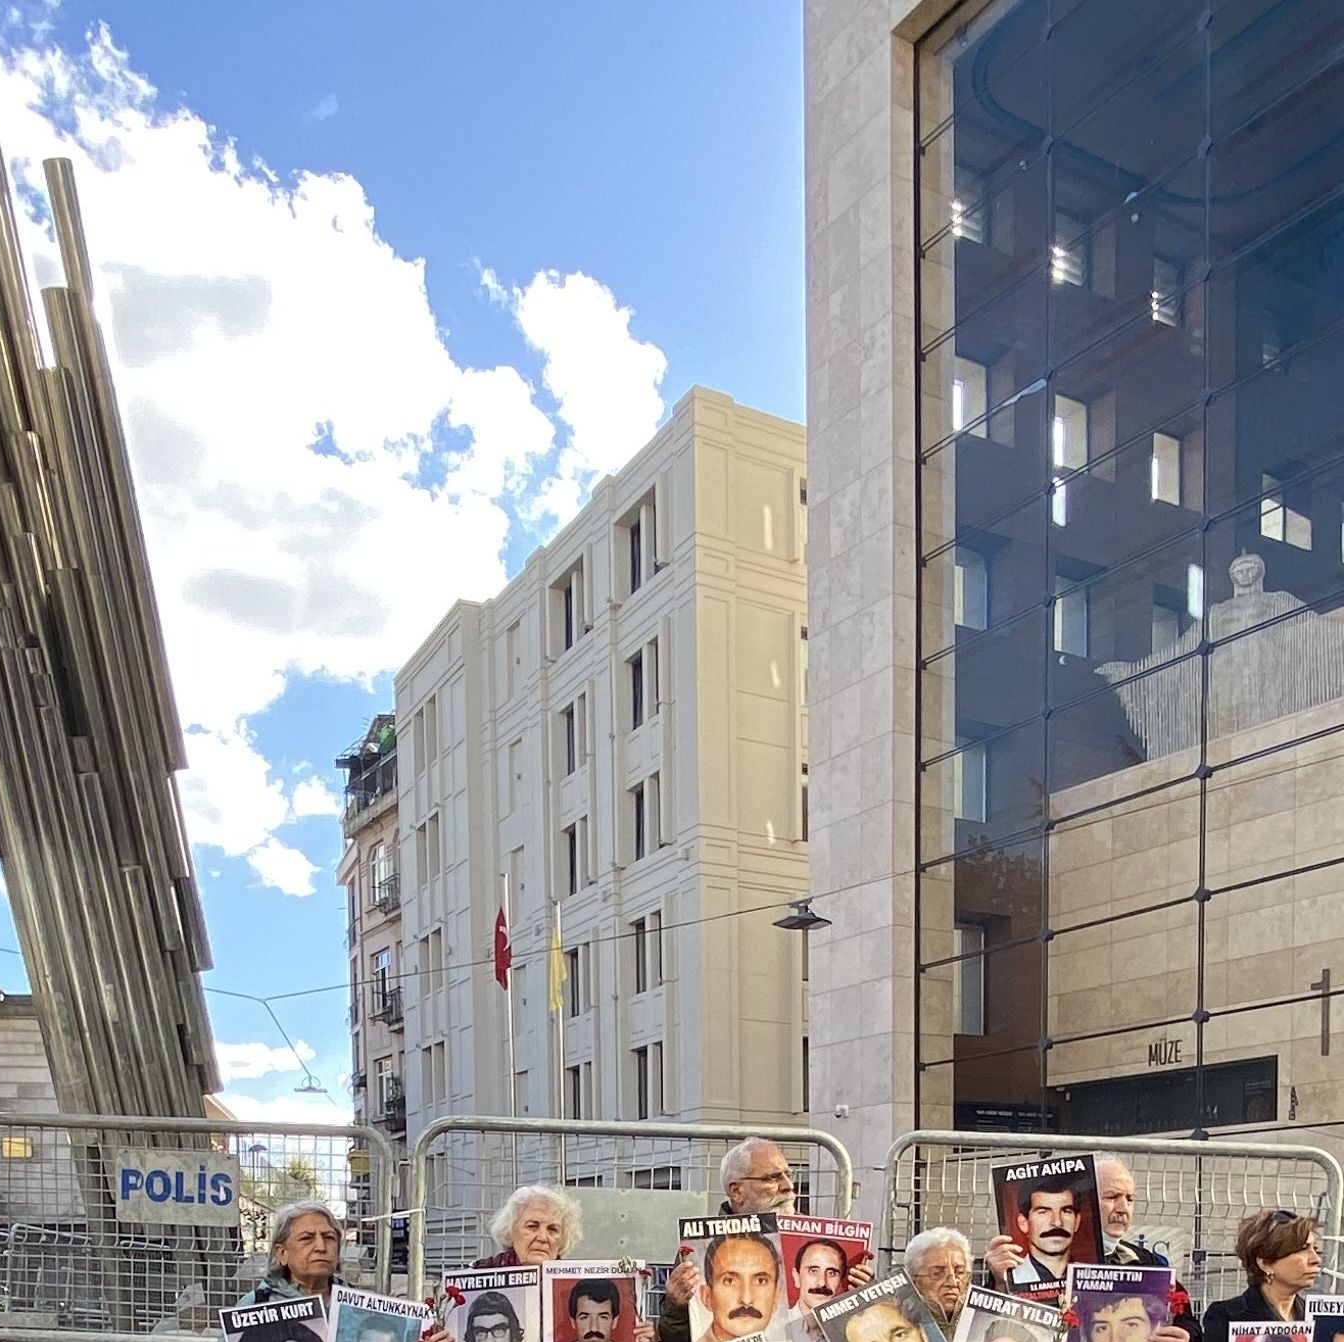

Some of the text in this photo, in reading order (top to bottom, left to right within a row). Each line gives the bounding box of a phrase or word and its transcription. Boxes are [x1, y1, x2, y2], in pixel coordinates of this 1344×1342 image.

[1148, 1038, 1183, 1067] MÜZE
[1006, 1159, 1085, 1182] AGİT AKİPA
[120, 1164, 233, 1207] POLİS
[683, 1215, 761, 1237] ALİ TEKDAĞ
[826, 1222, 870, 1239] BİLGİN
[509, 1271, 536, 1285] EREN
[584, 1264, 610, 1274] NEZİR
[1076, 1280, 1114, 1291] YAMAN
[231, 1302, 314, 1329] ÜZEYİR KURT
[337, 1290, 431, 1320] DAVUT ALTUNKAYNAK
[820, 1295, 860, 1322] AHMET
[970, 1291, 1019, 1317] MURAT
[1232, 1323, 1312, 1335] NİHAT AYDOĞAN
